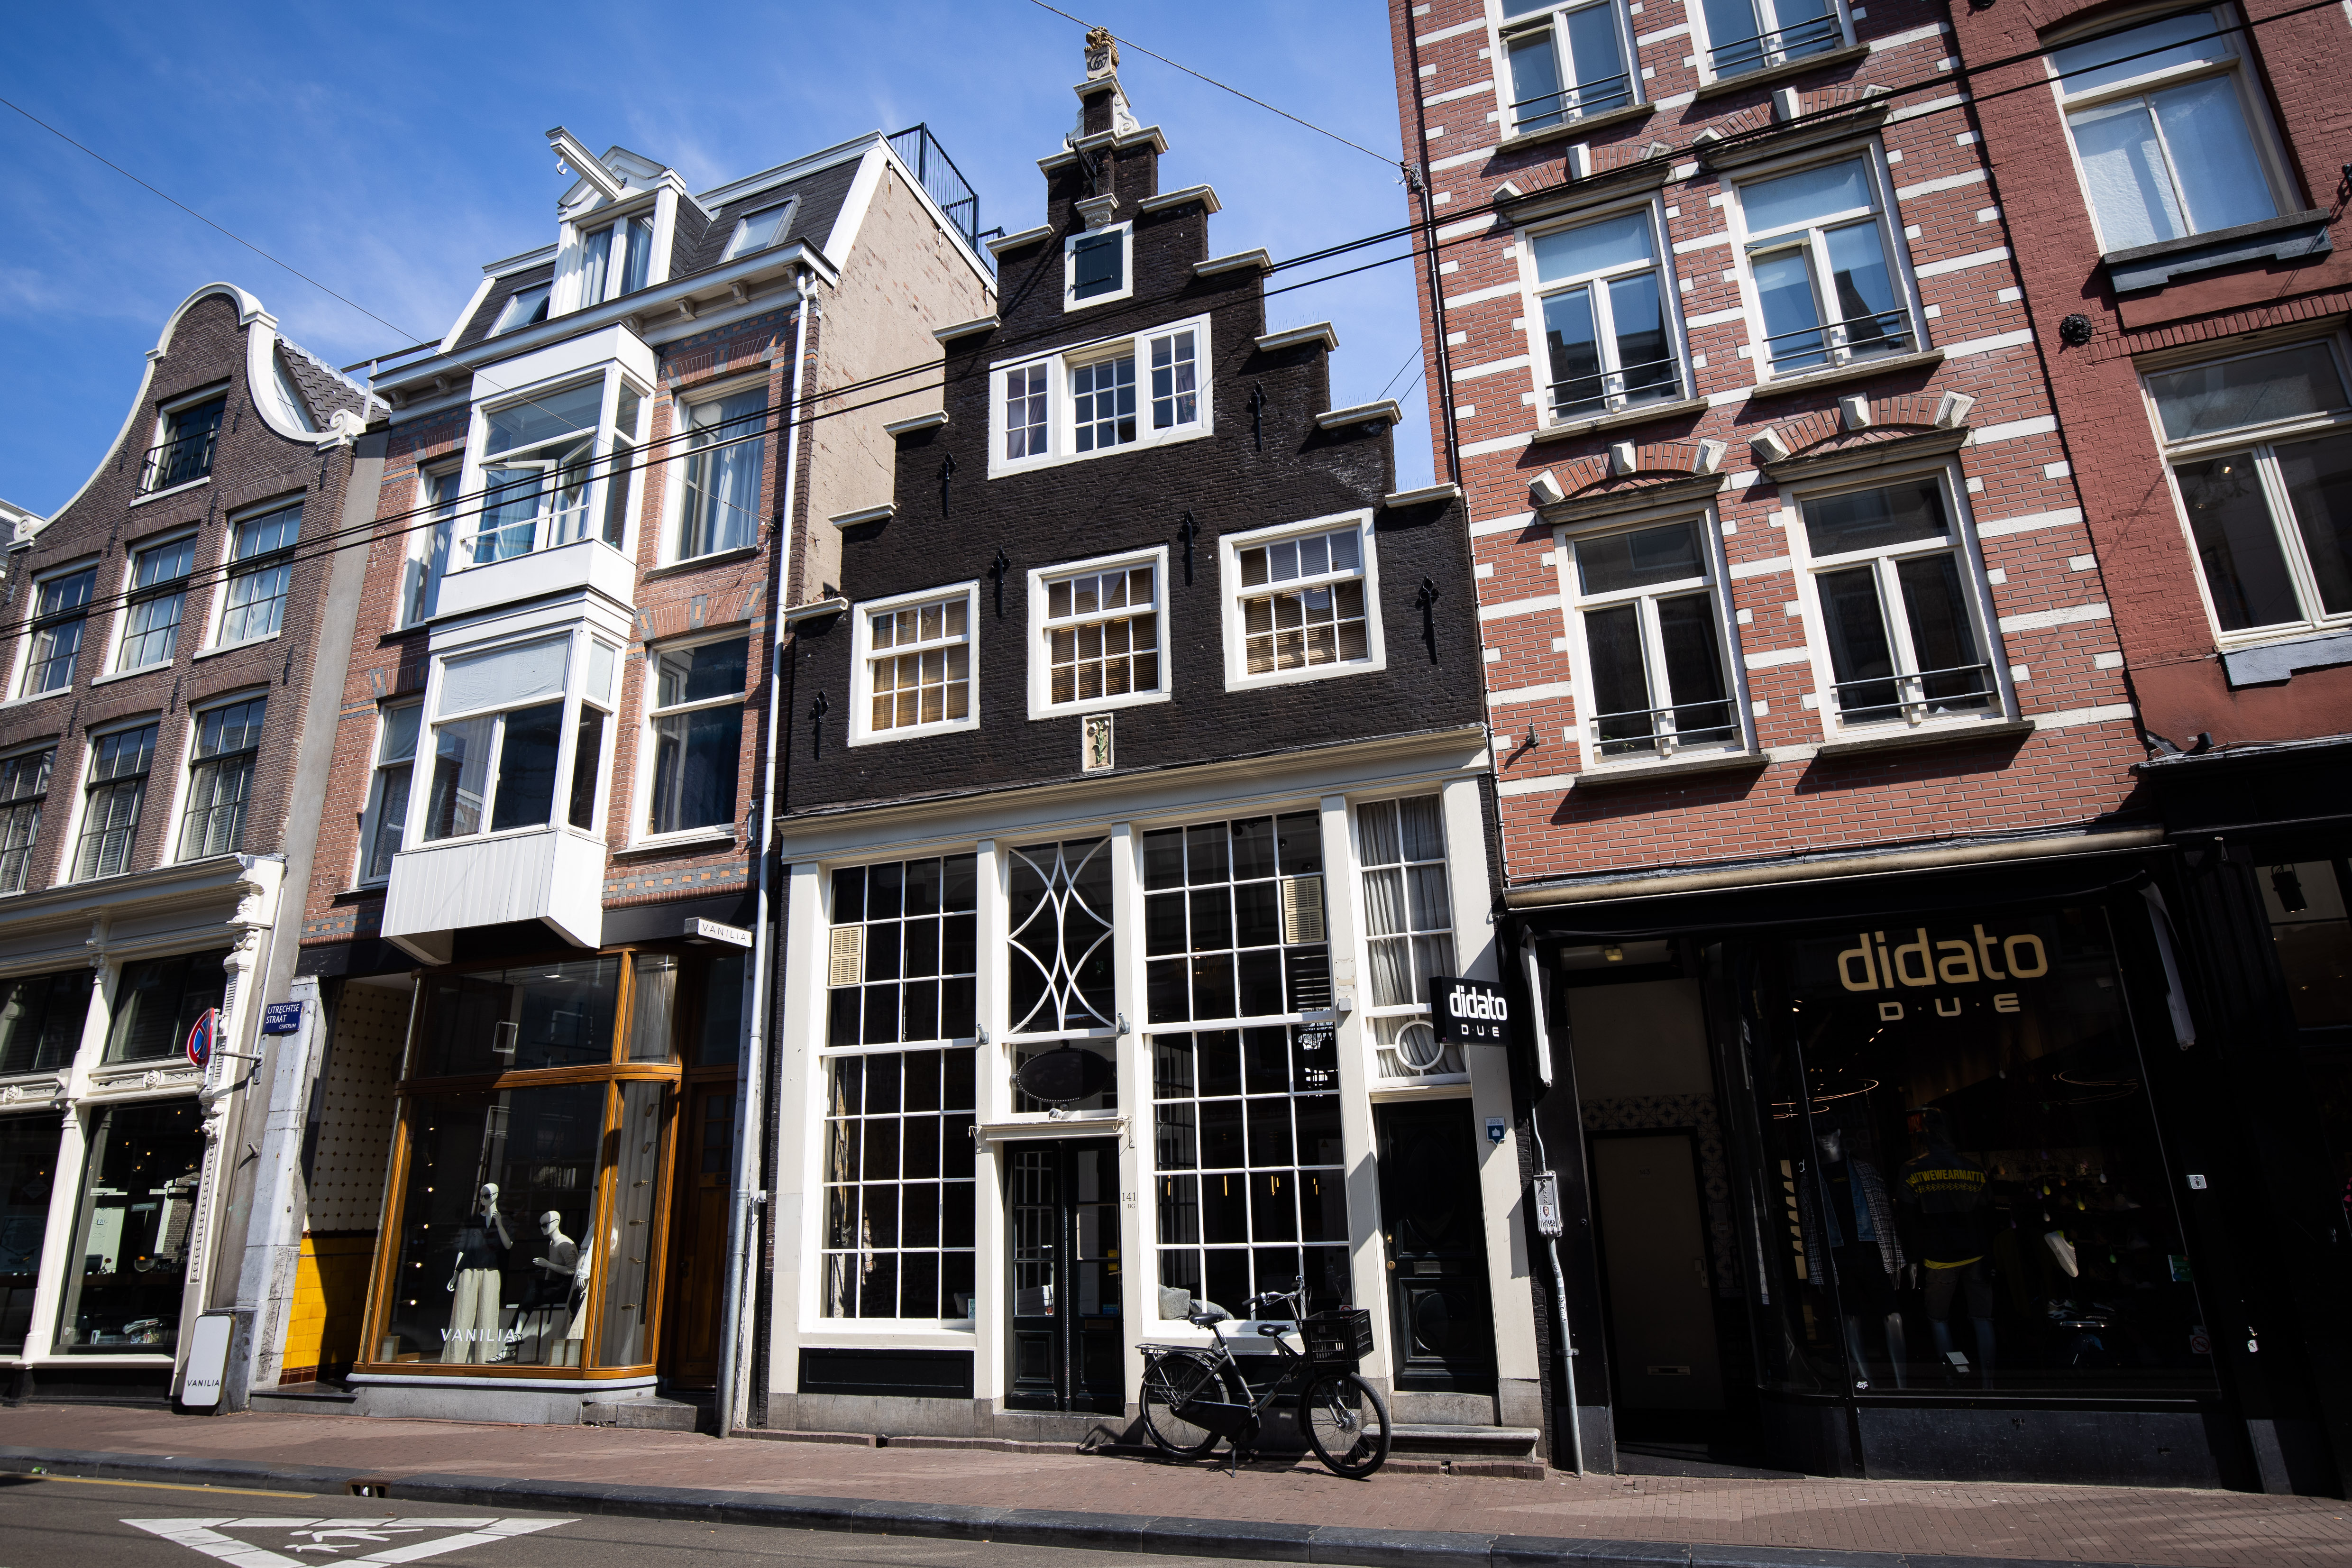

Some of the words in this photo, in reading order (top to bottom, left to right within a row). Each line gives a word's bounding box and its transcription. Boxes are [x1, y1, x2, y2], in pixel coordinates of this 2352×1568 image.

[1087, 52, 1108, 72] 1667
[702, 923, 747, 942] VANILIA
[1838, 924, 2048, 992] didato
[268, 1004, 300, 1014] UTRECHTSE
[1449, 985, 1507, 1021] didato
[266, 1015, 287, 1024] STRAAT
[1122, 1192, 1136, 1201] 141
[441, 1328, 515, 1342] VANILIA
